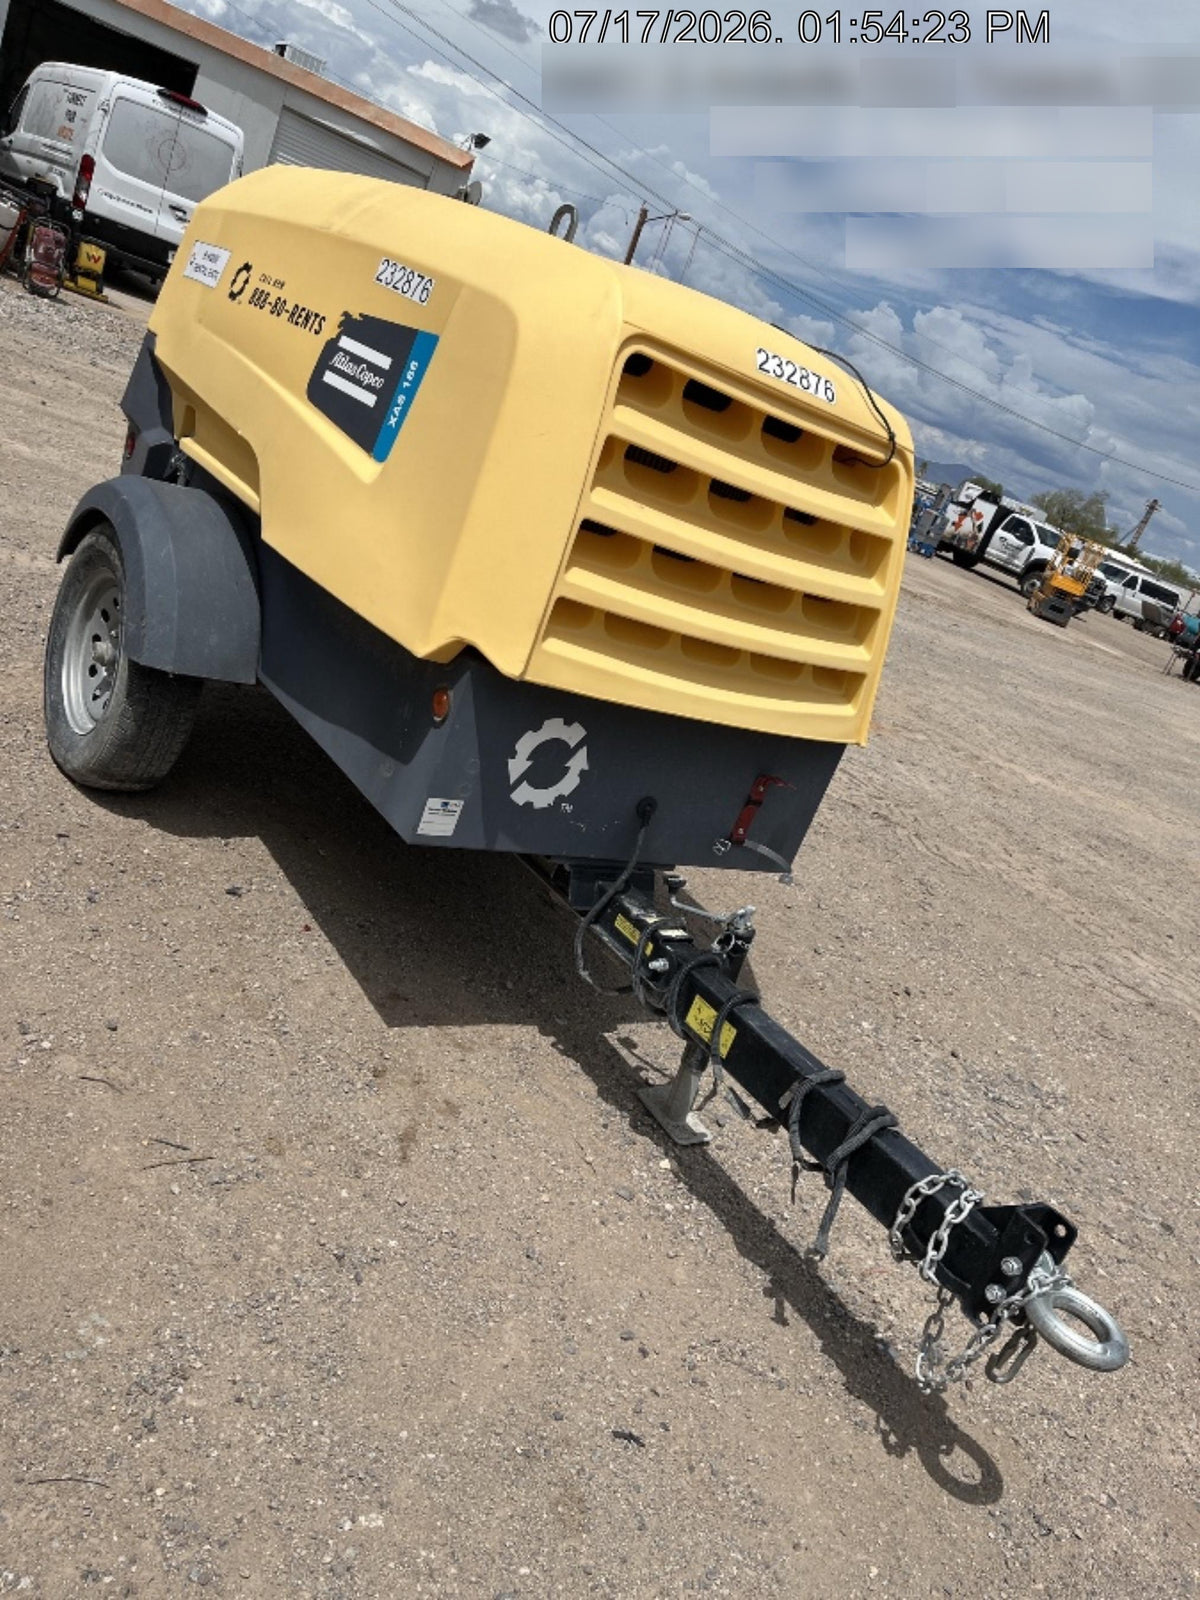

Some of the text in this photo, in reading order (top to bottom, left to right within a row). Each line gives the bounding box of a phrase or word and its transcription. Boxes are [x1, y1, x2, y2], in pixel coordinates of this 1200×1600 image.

[376, 258, 433, 304] 232876
[248, 287, 326, 335] 888-80-RENTS
[329, 351, 385, 390] Atlas Copco
[756, 347, 835, 403] 232876
[387, 394, 406, 428] XAS
